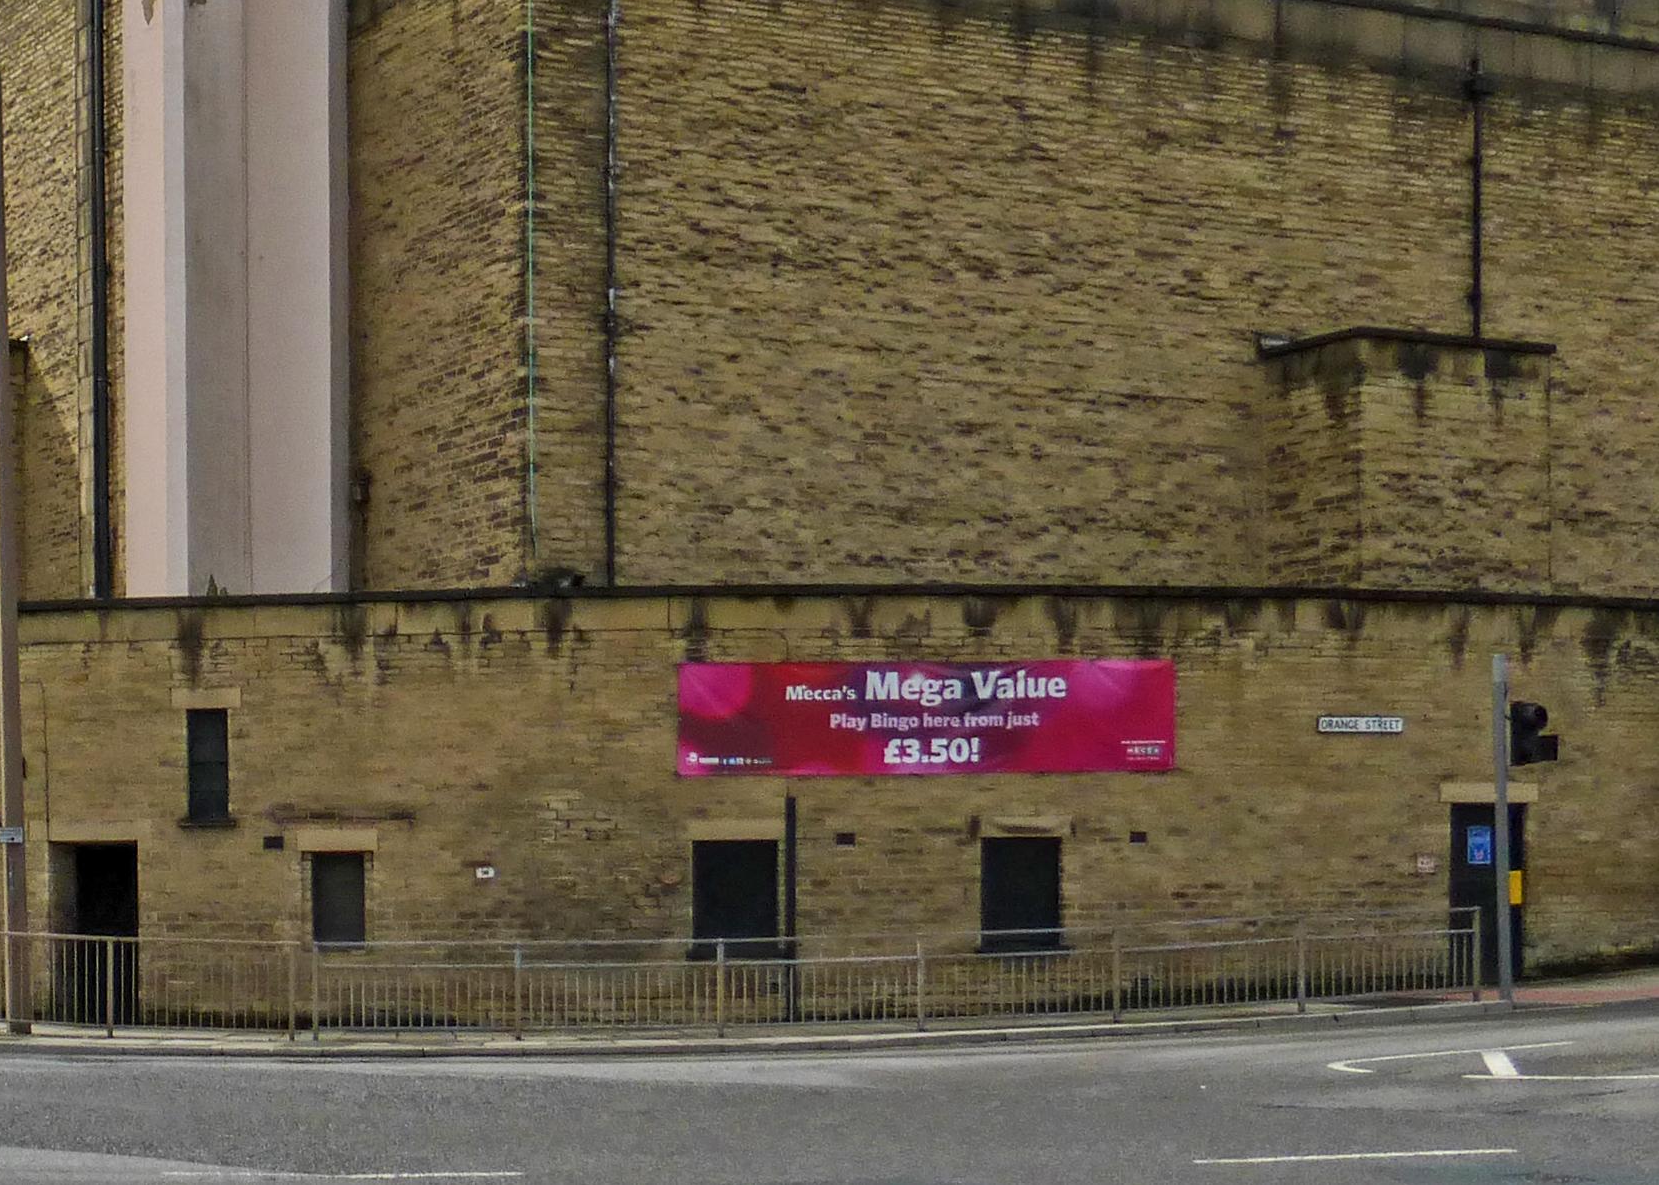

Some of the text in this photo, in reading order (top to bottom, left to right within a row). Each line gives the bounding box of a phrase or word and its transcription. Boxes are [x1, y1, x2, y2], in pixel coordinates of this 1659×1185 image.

[785, 668, 1068, 707] Mecca's Mega Value
[829, 710, 1040, 731] Play Bingo here from just
[1321, 719, 1400, 730] ORANGE STREET
[883, 736, 981, 764] £3.50!
